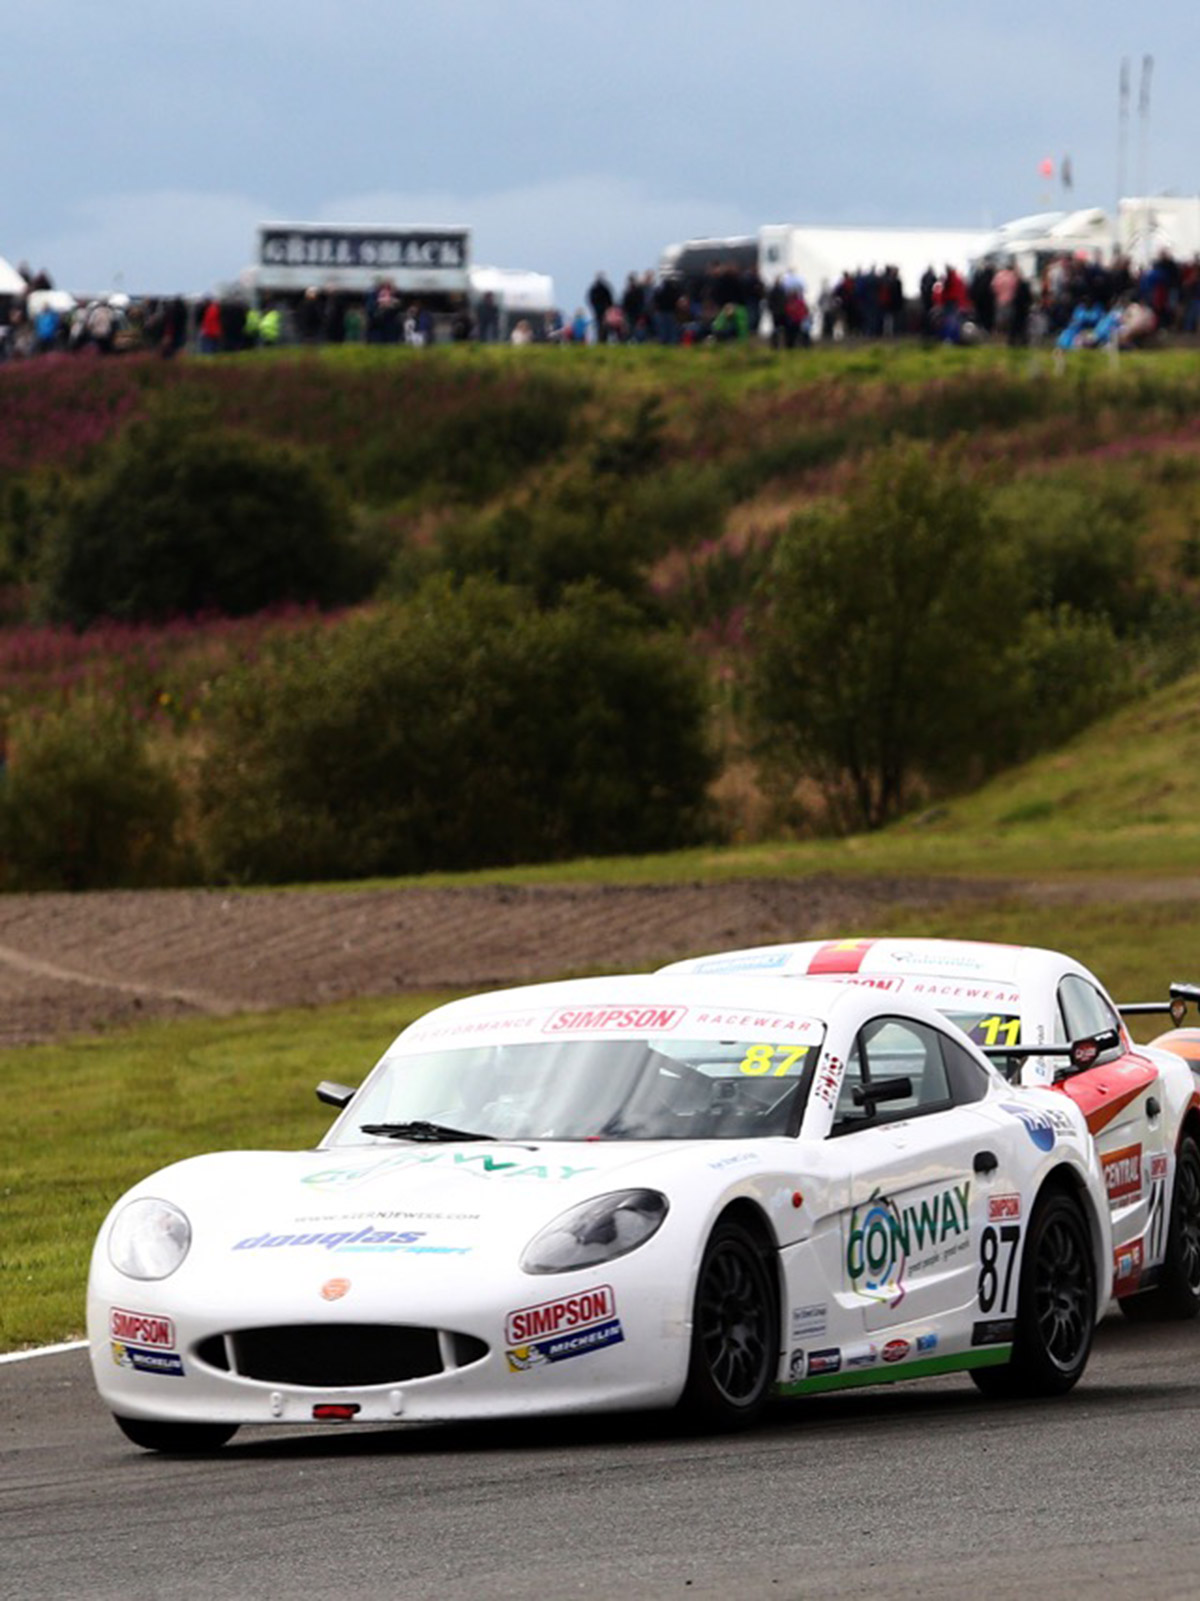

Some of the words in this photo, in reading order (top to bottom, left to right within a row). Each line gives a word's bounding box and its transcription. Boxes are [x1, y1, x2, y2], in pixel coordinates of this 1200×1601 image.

[265, 235, 352, 264] GRILL
[913, 983, 1020, 1003] RACEWEAR
[411, 1016, 536, 1042] PERFORMANCE
[551, 1009, 677, 1030] SIMPSON
[697, 1013, 812, 1031] RACEWEAR
[978, 1016, 1021, 1047] 11
[739, 1043, 811, 1077] 87
[1104, 1154, 1139, 1190] CENTRAL
[231, 1225, 428, 1251] douglas
[847, 1182, 971, 1280] CONWAY
[978, 1225, 1020, 1314] 87
[110, 1311, 171, 1346] SIMPSON
[511, 1289, 609, 1338] SIMPSON
[548, 1326, 621, 1356] MICHELIN
[132, 1352, 182, 1371] MICHELIN
